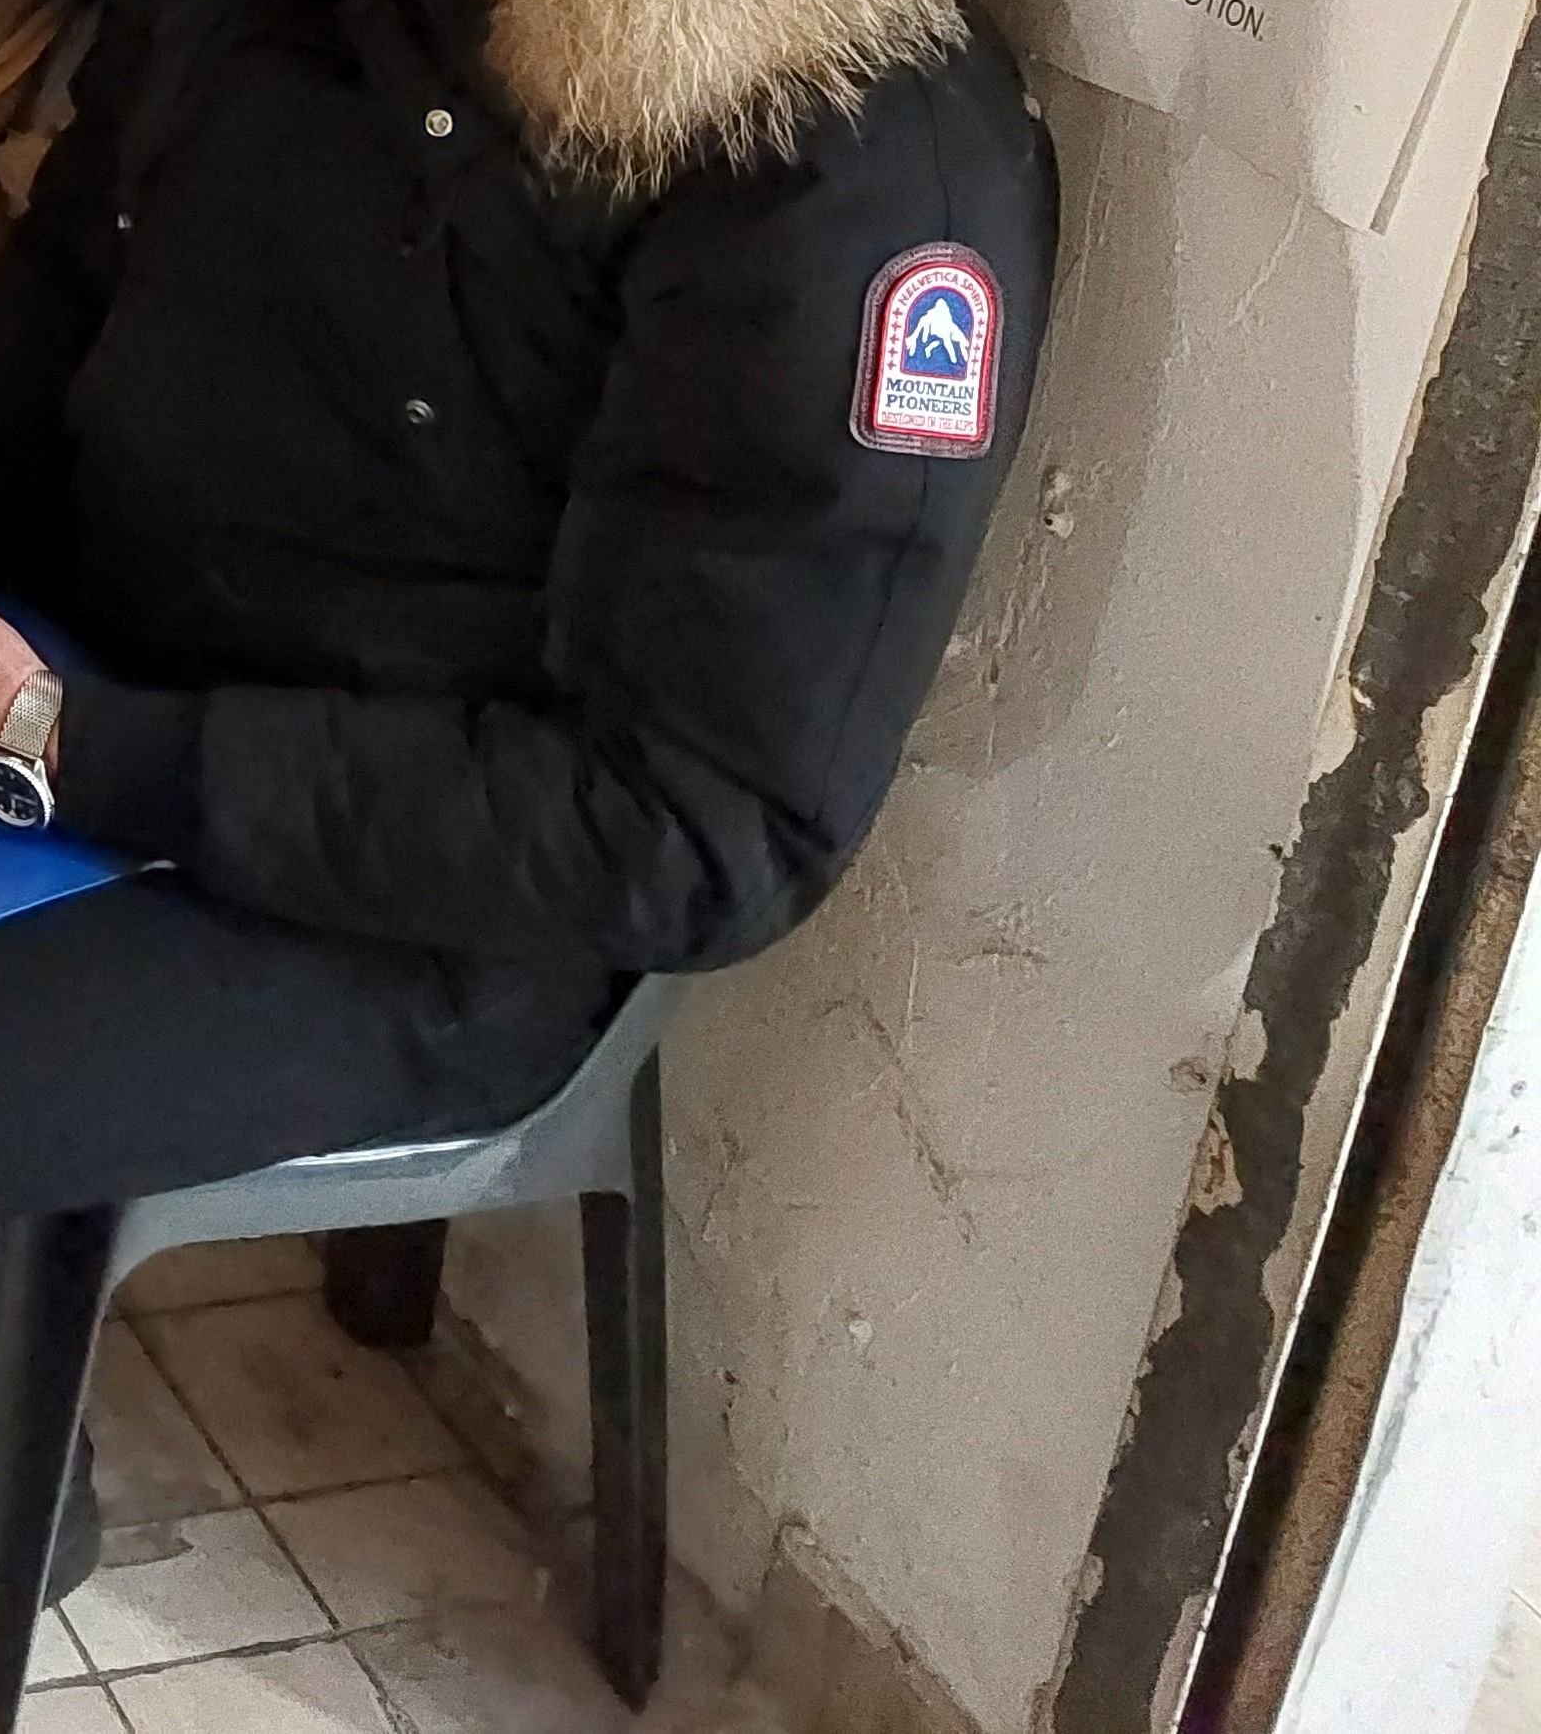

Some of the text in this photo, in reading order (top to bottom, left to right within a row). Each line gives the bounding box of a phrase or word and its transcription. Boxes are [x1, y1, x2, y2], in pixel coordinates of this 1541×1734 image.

[960, 278, 984, 313] SPIRIT
[885, 377, 974, 400] MOUNTAIN
[885, 394, 972, 416] PIONEERS
